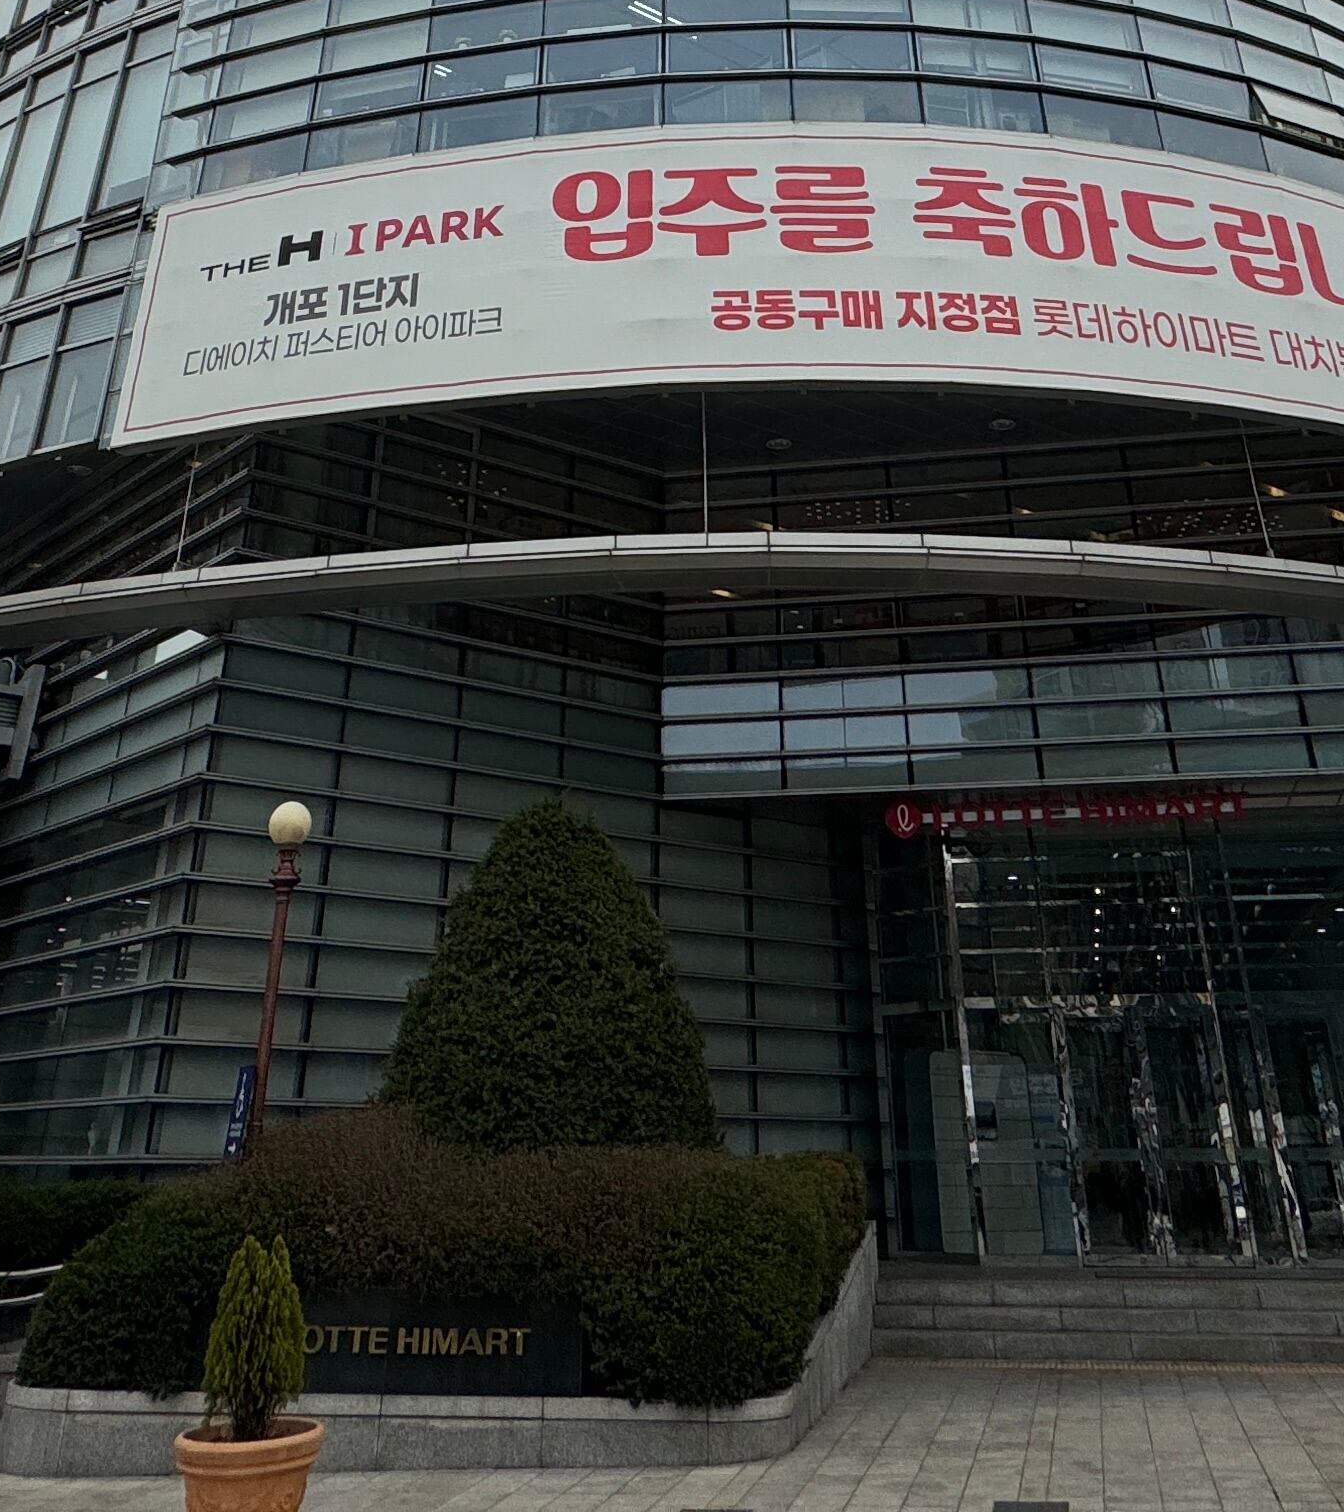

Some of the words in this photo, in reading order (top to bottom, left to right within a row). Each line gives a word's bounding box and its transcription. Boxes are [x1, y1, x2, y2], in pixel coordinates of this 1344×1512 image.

[552, 166, 876, 262] 입주를
[199, 253, 271, 282] THE
[277, 230, 322, 268] H
[263, 281, 328, 327] 개포
[338, 271, 420, 318] 1단지
[710, 288, 883, 332] 공동구매
[896, 291, 1020, 336] 지정점
[1032, 296, 1265, 363] 롯데하이마트
[182, 331, 278, 377] 디에이치
[283, 321, 387, 361] 퍼스티어
[395, 306, 503, 345] 아이파크
[933, 800, 1067, 832] LOTTE
[1080, 794, 1244, 824] HIMART
[304, 1325, 389, 1354] OTTE
[397, 1326, 531, 1355] HIMART
